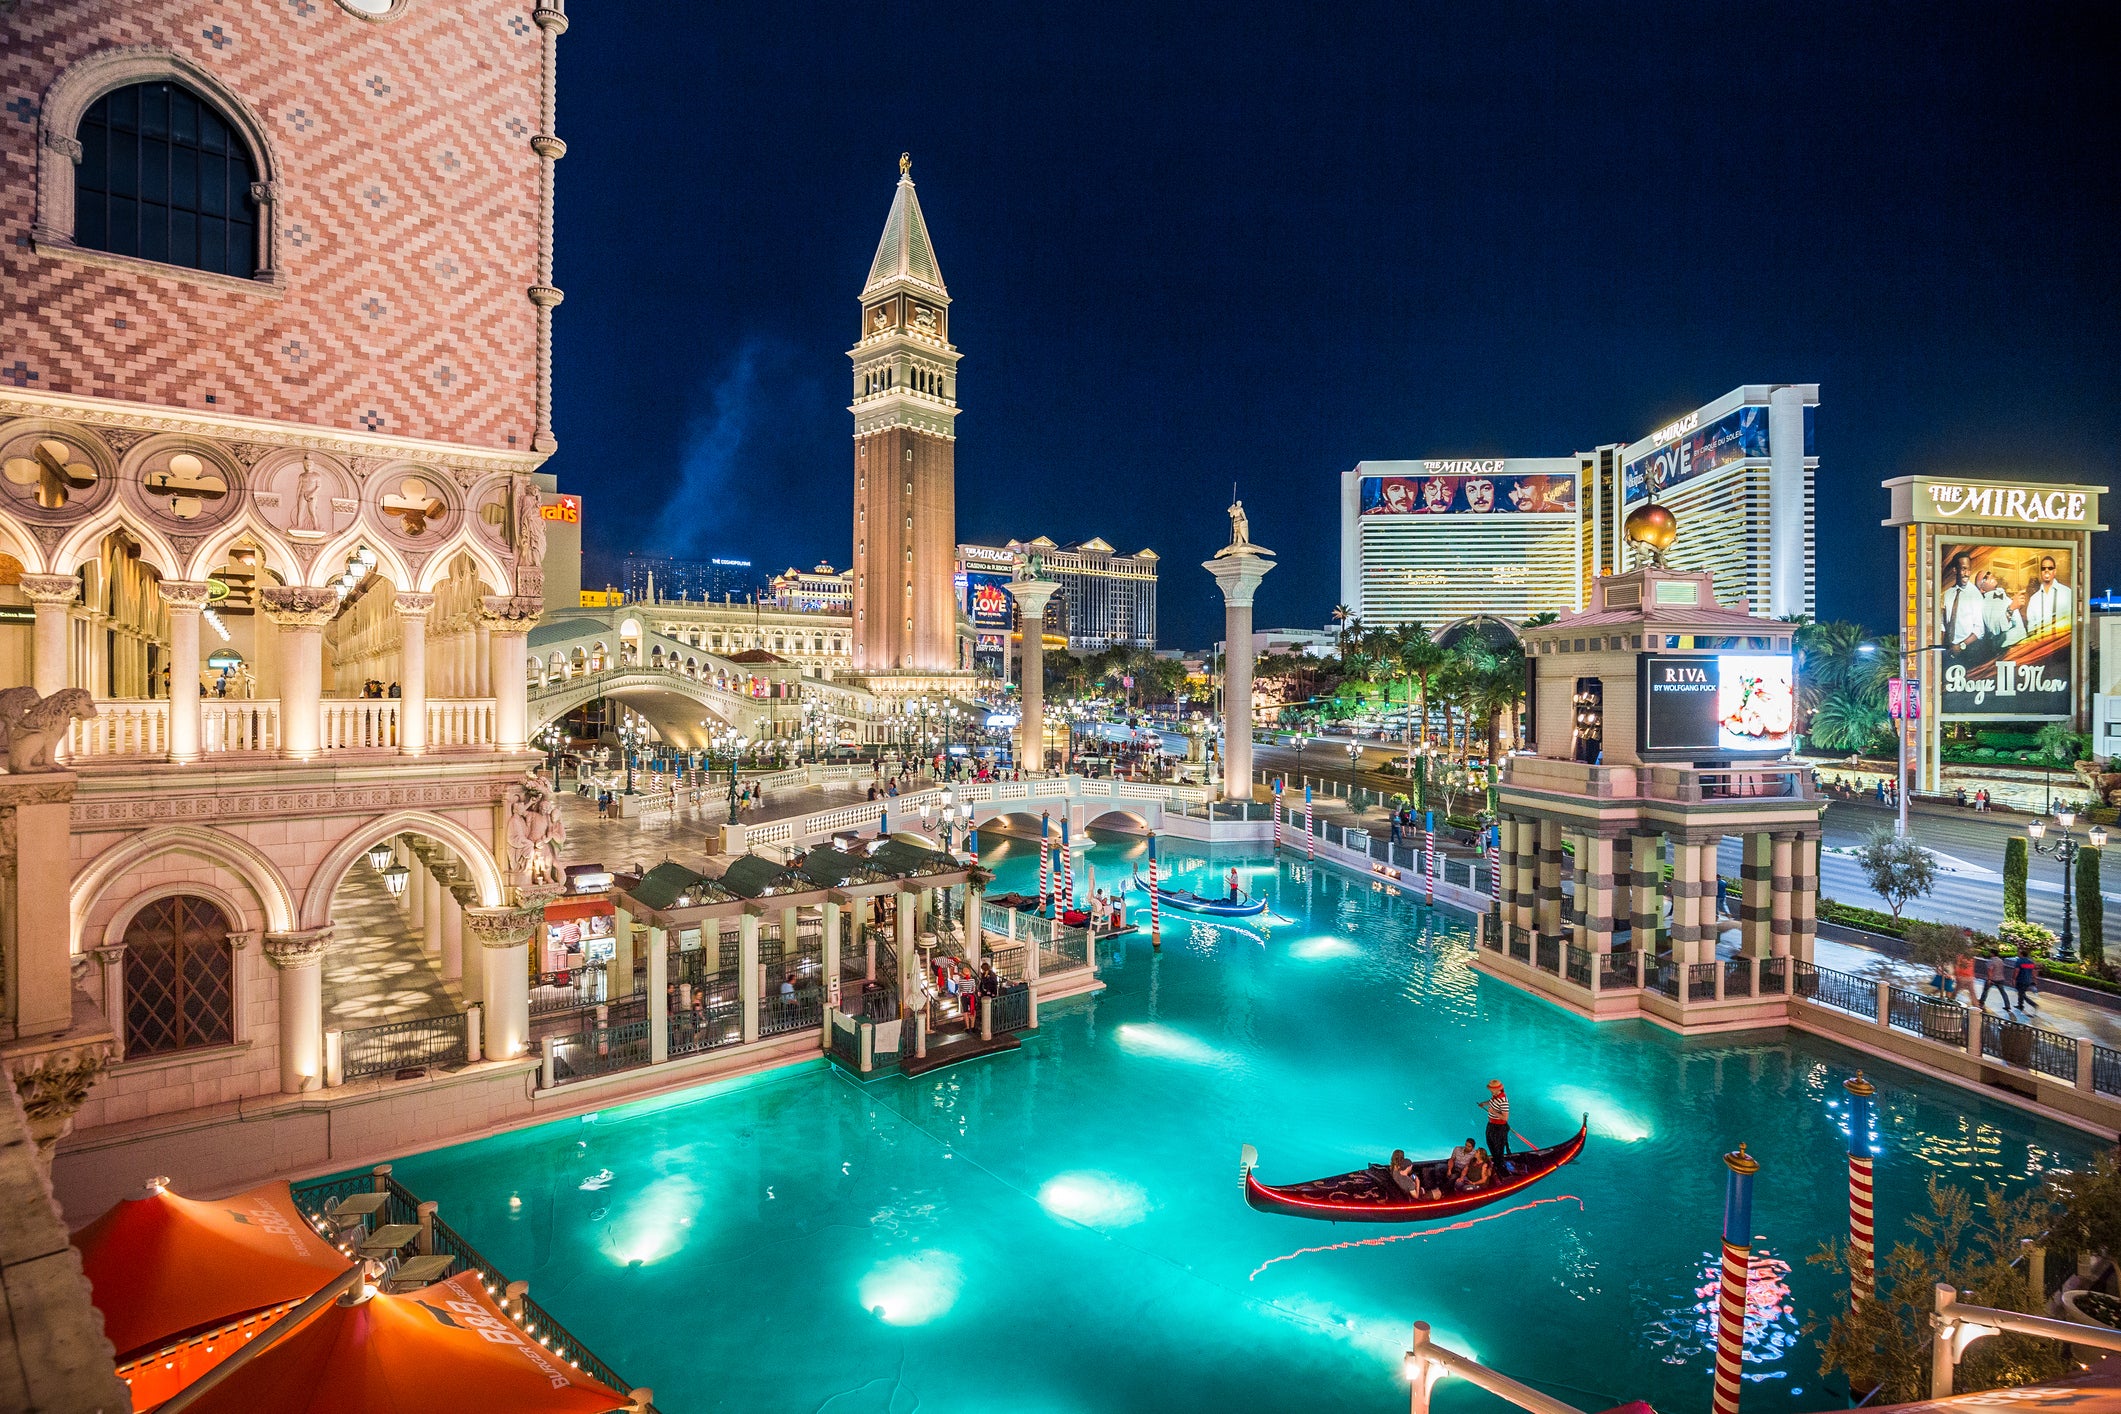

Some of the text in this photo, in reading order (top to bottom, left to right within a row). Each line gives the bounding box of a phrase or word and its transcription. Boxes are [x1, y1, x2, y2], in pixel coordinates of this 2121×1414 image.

[1655, 413, 1698, 446] MIRAGE
[1424, 461, 1504, 474] THE MIRAGE
[1650, 442, 1692, 484] OVE
[1929, 486, 2086, 522] THE MIRAGE
[968, 549, 1013, 561] MIRAGE
[973, 597, 1007, 612] LOVE
[1665, 668, 1707, 682] RIVA
[1945, 661, 2067, 705] Boyz II Men
[1909, 685, 1917, 697] LAS
[1909, 697, 1917, 718] VEGAS
[446, 1300, 526, 1346] B&B
[519, 1346, 571, 1389] BURGER
